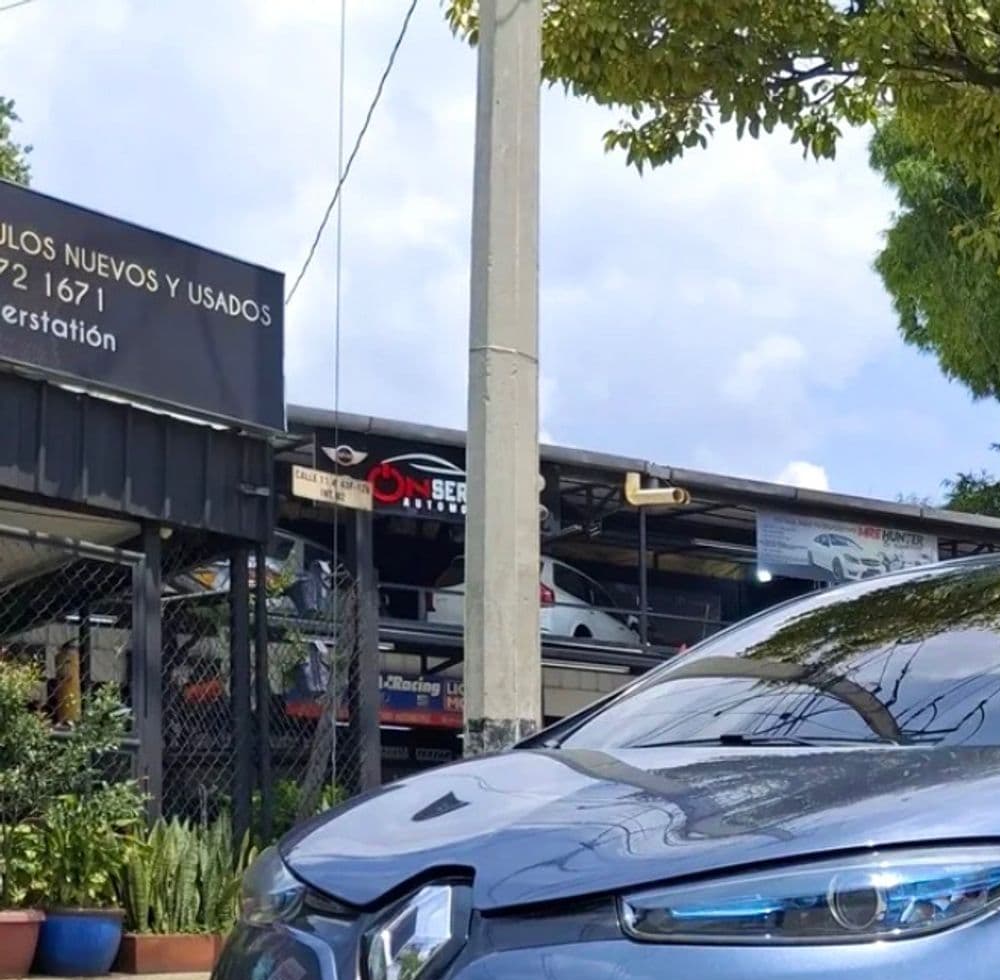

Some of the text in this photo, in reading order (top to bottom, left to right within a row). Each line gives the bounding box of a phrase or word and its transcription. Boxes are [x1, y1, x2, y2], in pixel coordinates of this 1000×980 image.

[45, 272, 104, 313] 1671
[65, 243, 159, 292] NUEVOS
[166, 274, 180, 298] Y
[188, 282, 272, 326] USADOS
